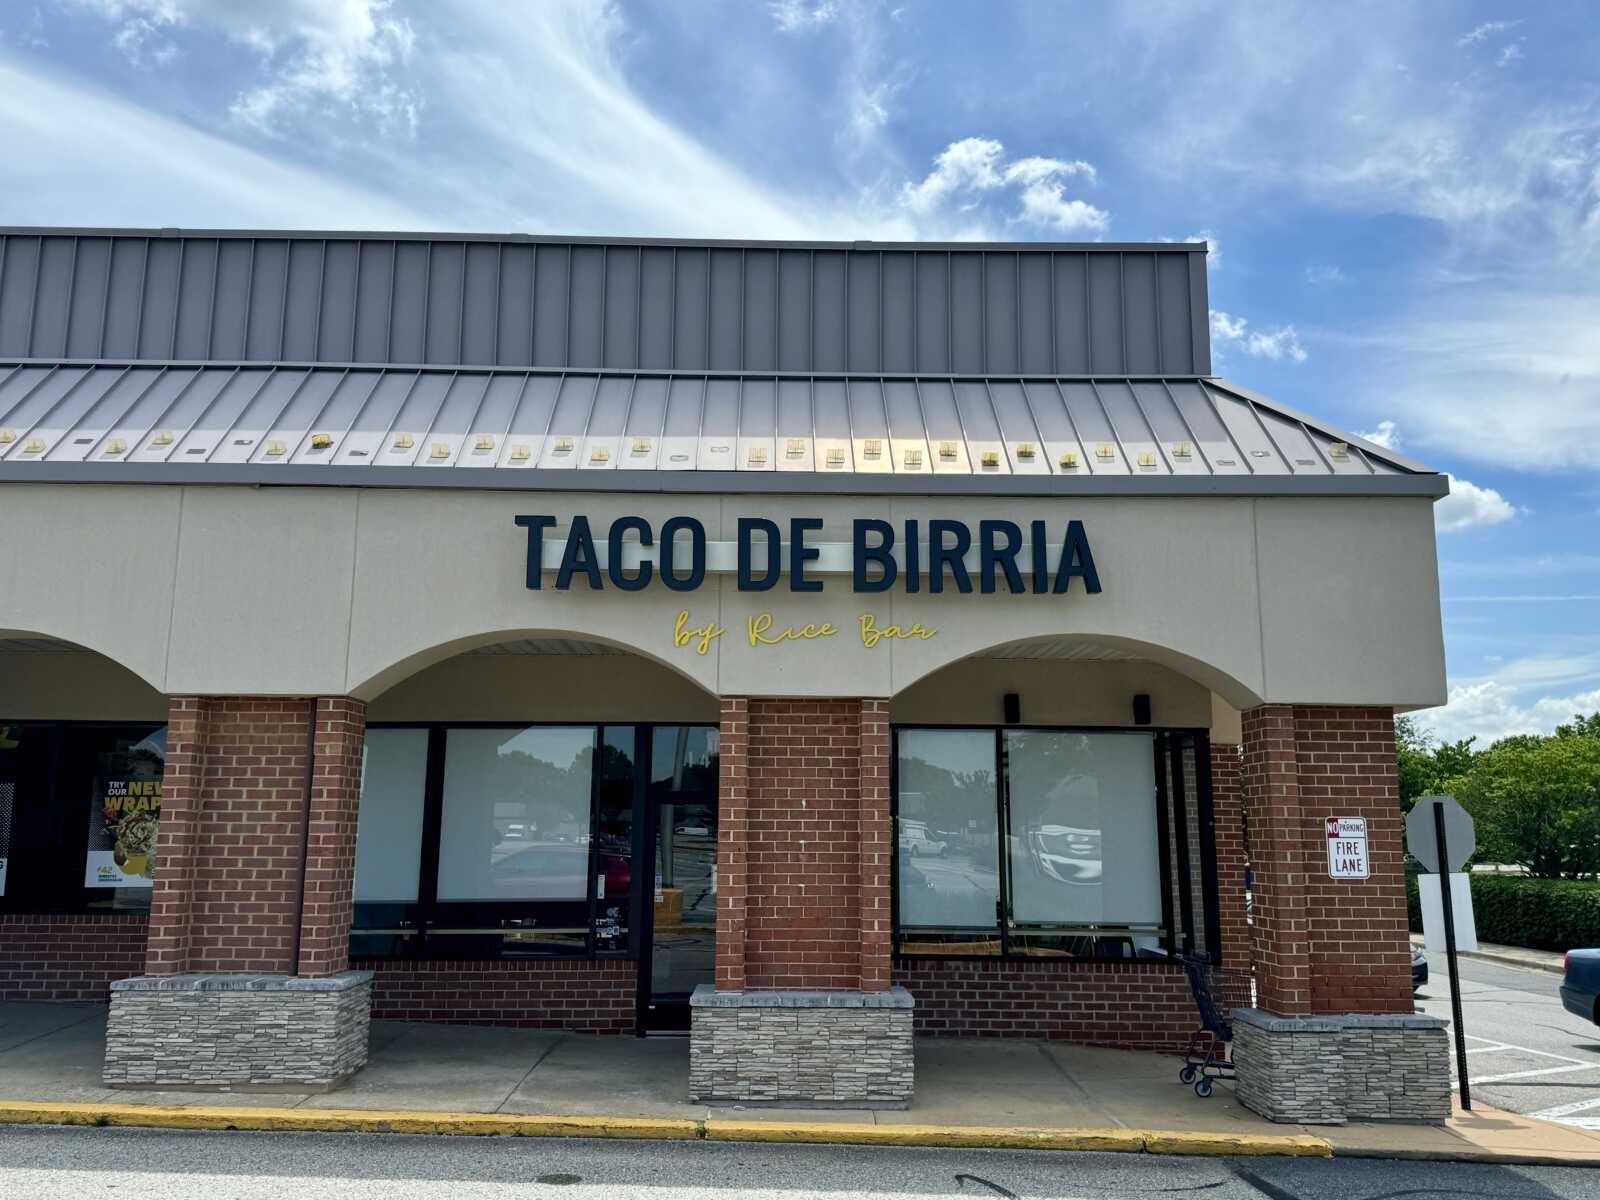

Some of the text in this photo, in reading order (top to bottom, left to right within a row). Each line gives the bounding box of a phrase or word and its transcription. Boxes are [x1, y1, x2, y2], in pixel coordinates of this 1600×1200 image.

[514, 515, 1102, 594] TACO DE BIRRIA
[673, 609, 937, 655] by Rice Bar
[1327, 822, 1364, 834] NO PARKING
[1336, 842, 1359, 855] FIRE
[1335, 859, 1363, 872] LANE
